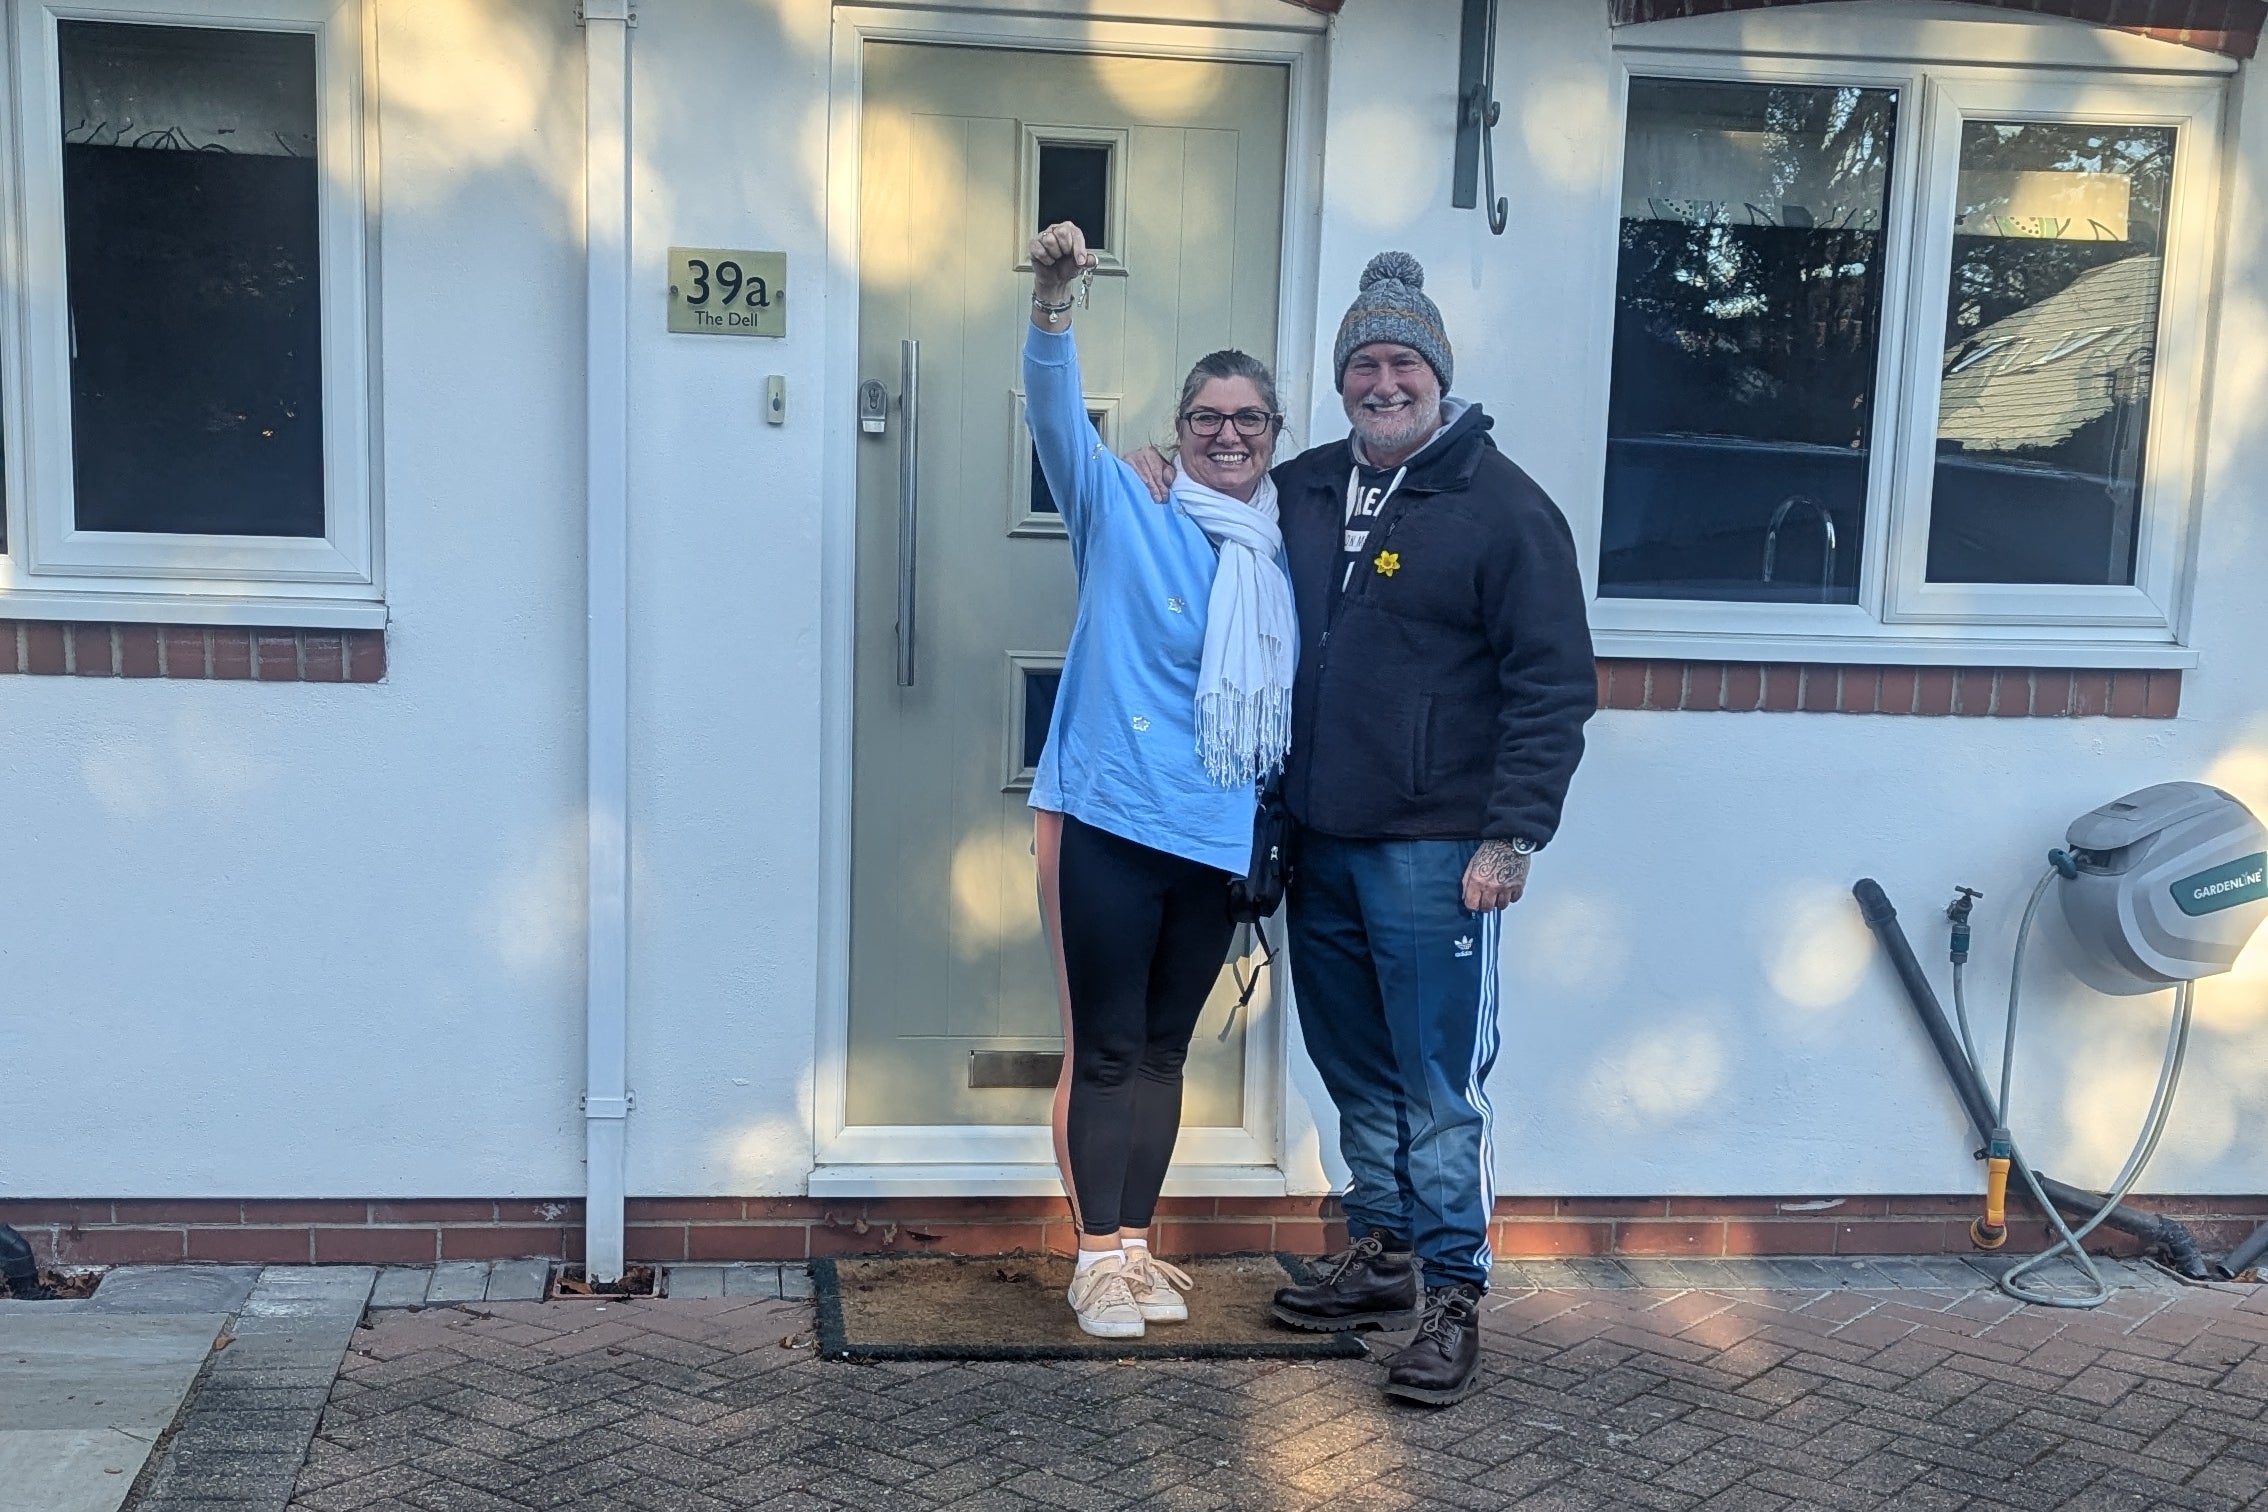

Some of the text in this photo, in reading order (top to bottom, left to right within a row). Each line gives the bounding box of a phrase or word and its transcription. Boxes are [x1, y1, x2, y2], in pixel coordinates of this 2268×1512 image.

[686, 259, 770, 307] 39a
[694, 310, 758, 327] The Dell
[2193, 870, 2262, 900] GARDENLINE
